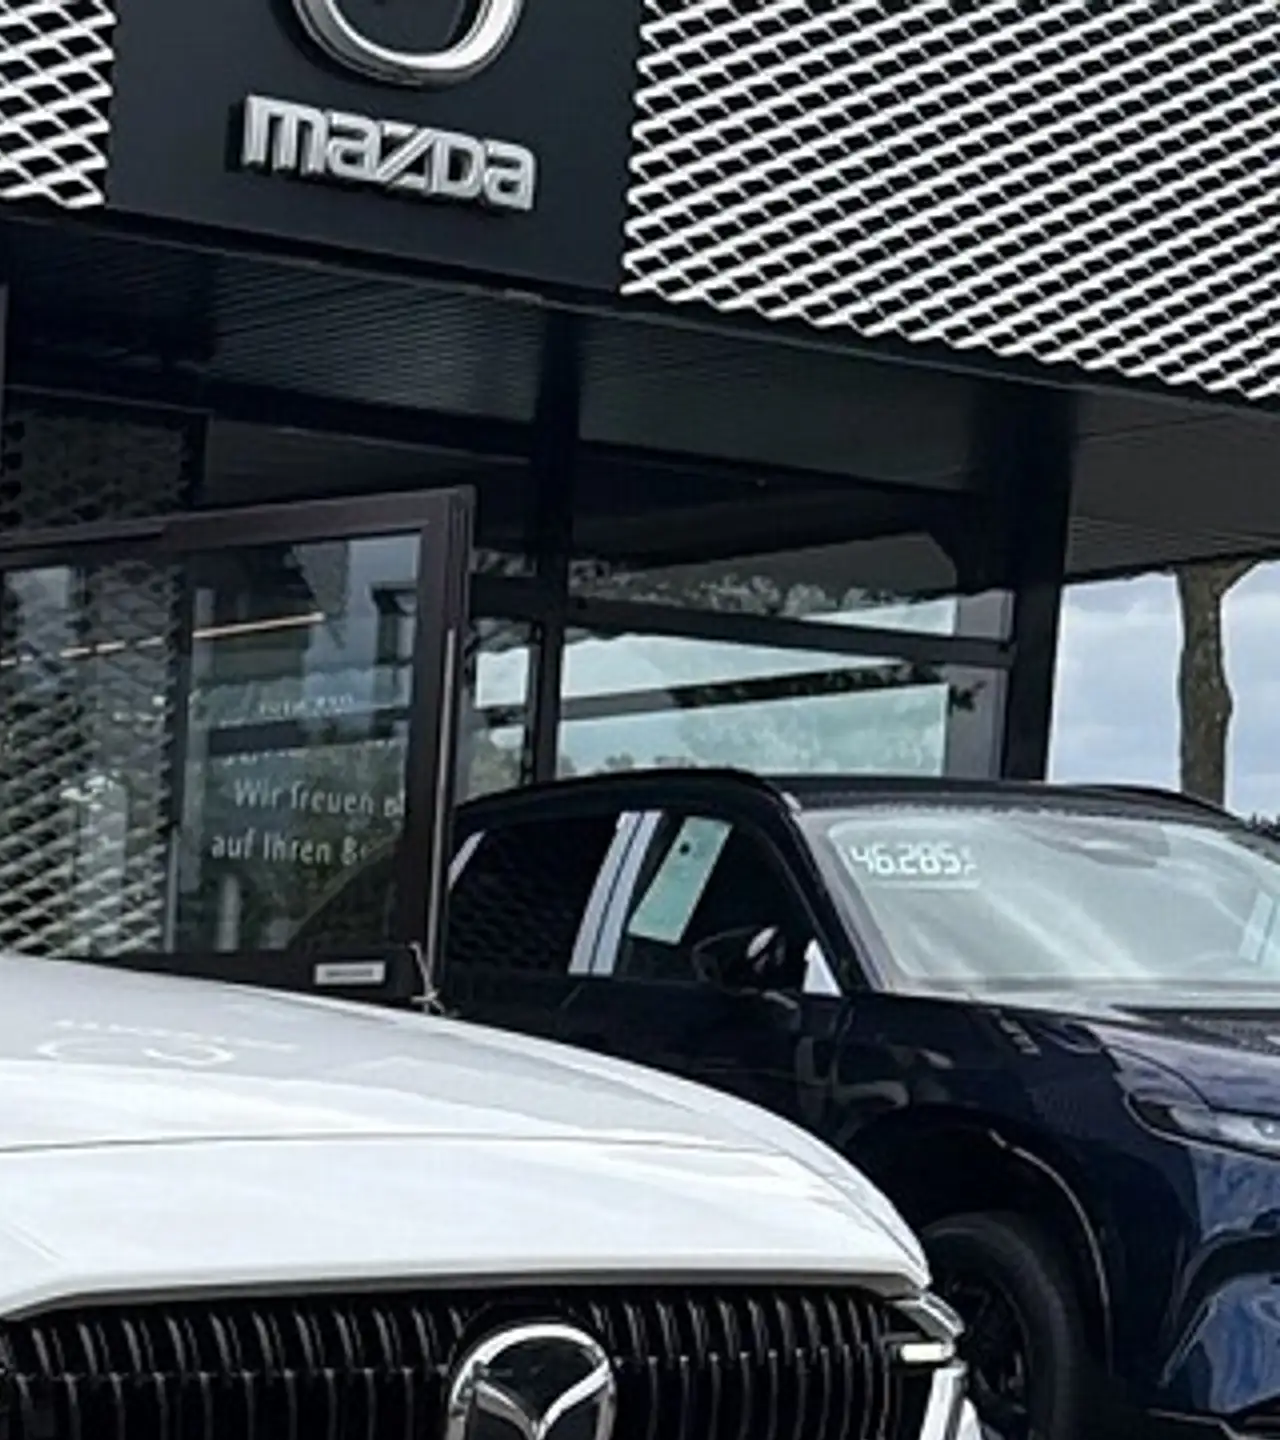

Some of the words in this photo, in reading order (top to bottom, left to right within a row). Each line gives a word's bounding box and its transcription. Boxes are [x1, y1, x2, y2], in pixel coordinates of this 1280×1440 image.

[243, 94, 536, 211] mazda
[235, 778, 282, 808] Wir
[291, 780, 374, 815] freuen
[211, 828, 256, 859] auf
[263, 831, 331, 865] Ihren
